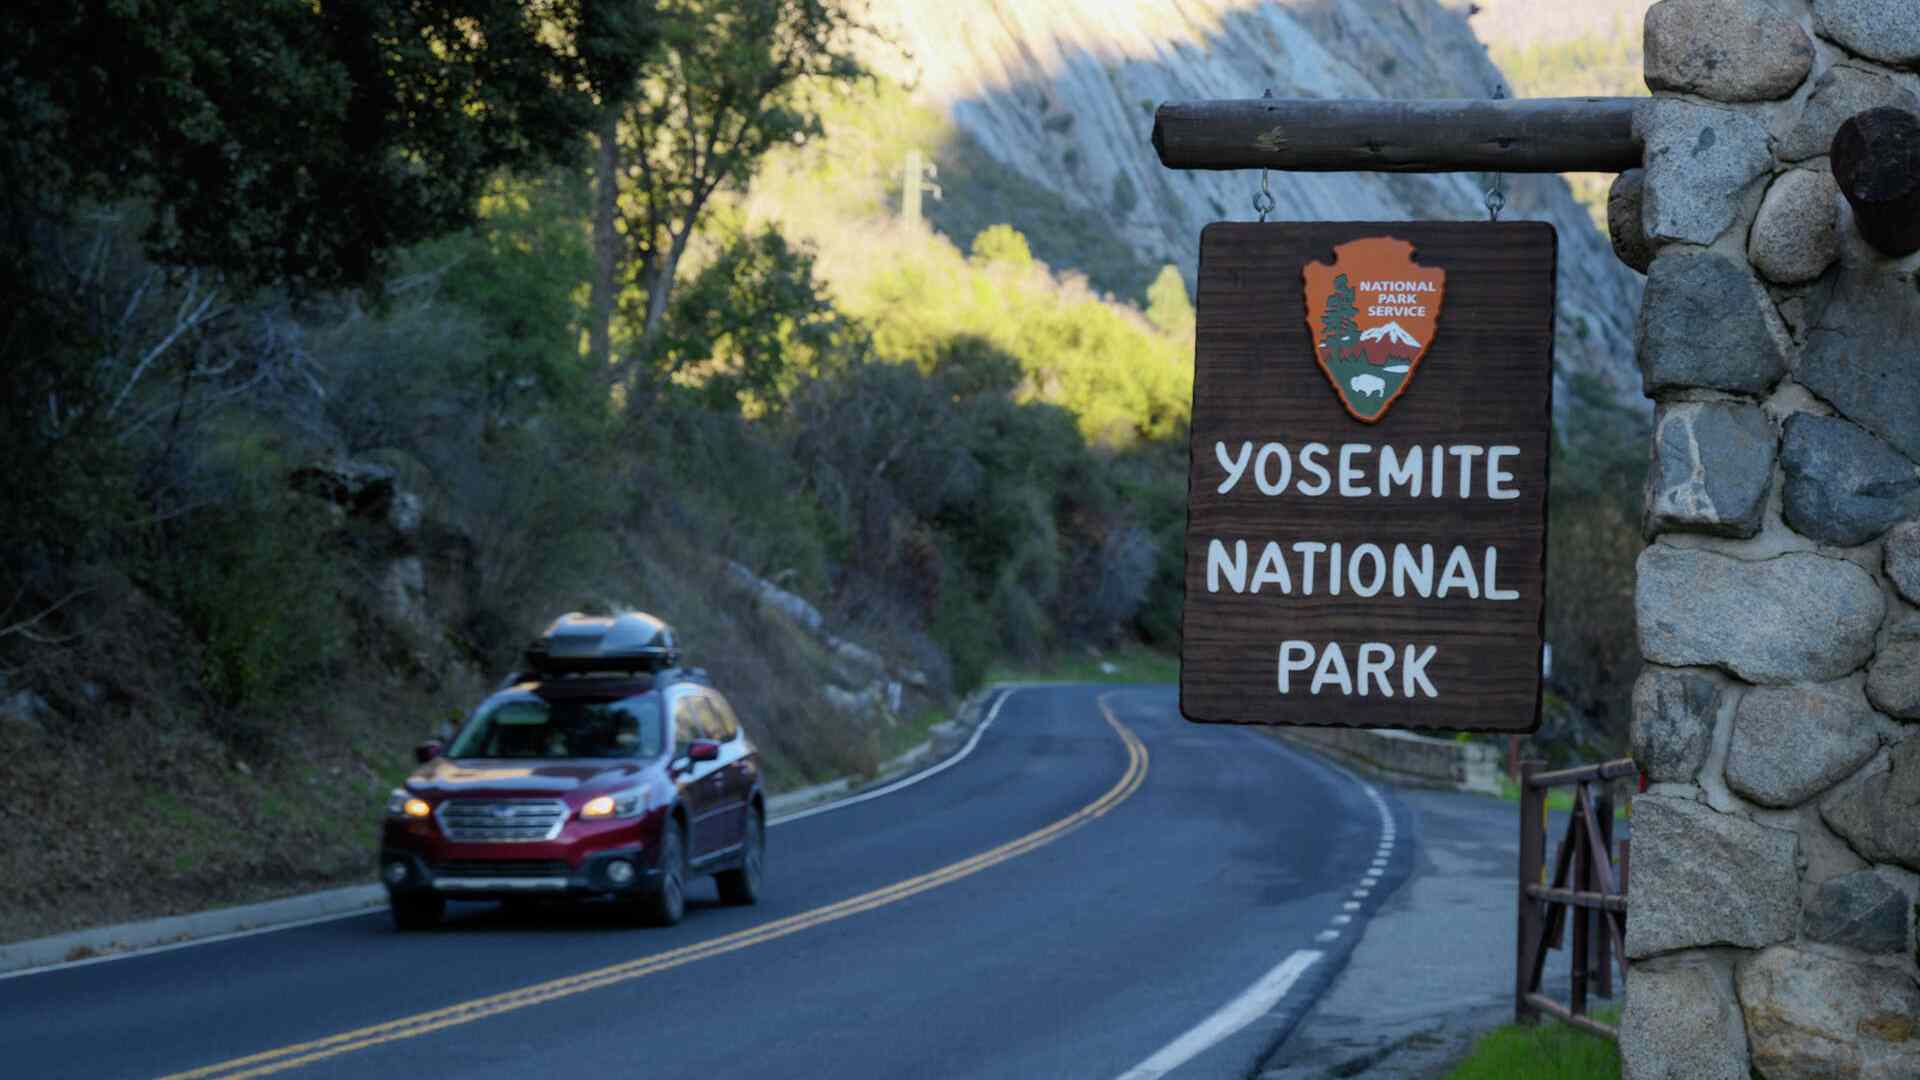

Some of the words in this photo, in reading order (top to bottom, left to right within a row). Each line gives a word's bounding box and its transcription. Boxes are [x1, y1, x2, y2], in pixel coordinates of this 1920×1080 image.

[1359, 281, 1437, 292] NATIONAL
[1377, 293, 1417, 304] PARK
[1367, 306, 1426, 317] SERVICE
[1215, 441, 1520, 499] YOSEMITE
[1207, 539, 1519, 600] NATIONAL
[1278, 640, 1438, 698] PARK
